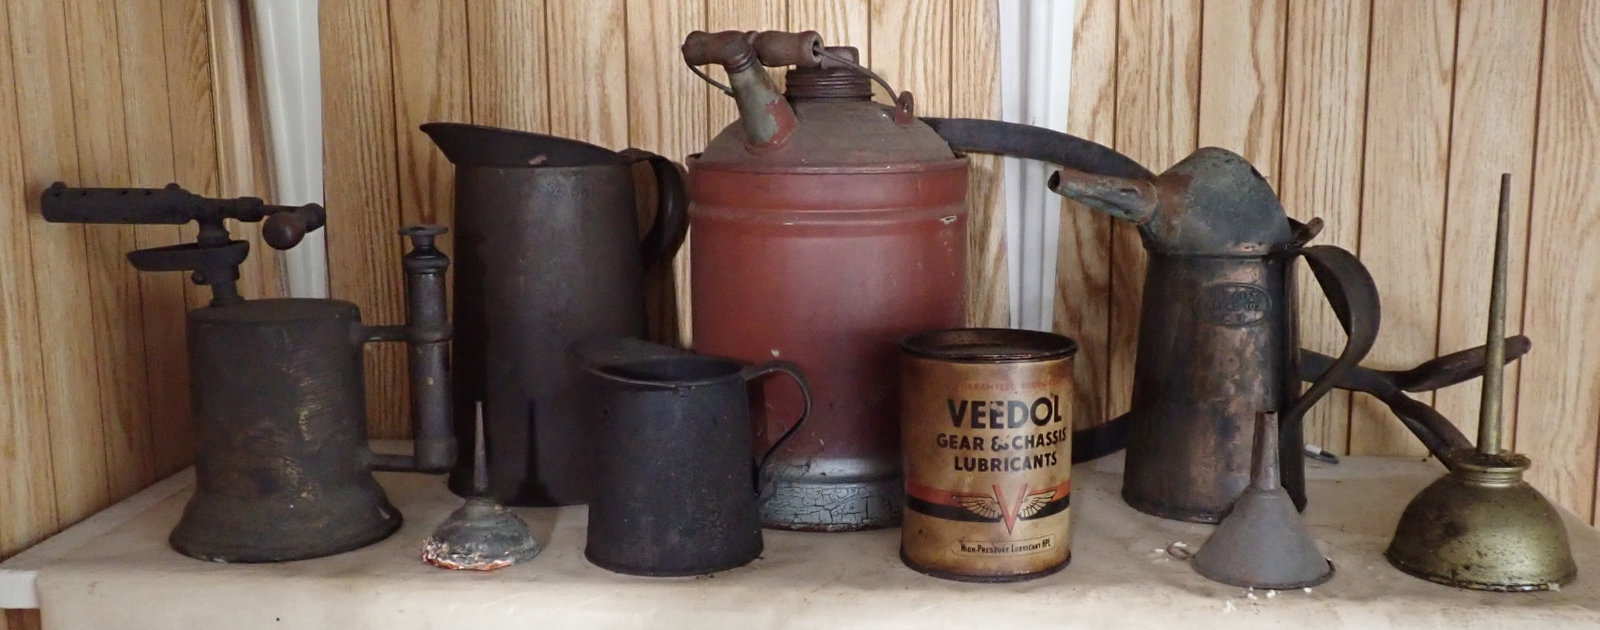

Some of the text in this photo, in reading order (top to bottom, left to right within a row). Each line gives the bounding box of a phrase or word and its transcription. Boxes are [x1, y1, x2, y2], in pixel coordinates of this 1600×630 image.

[947, 394, 1063, 429] VEEDOL
[936, 427, 1067, 452] GEAR & CHASSIS
[954, 451, 1057, 472] LUBRICANTS
